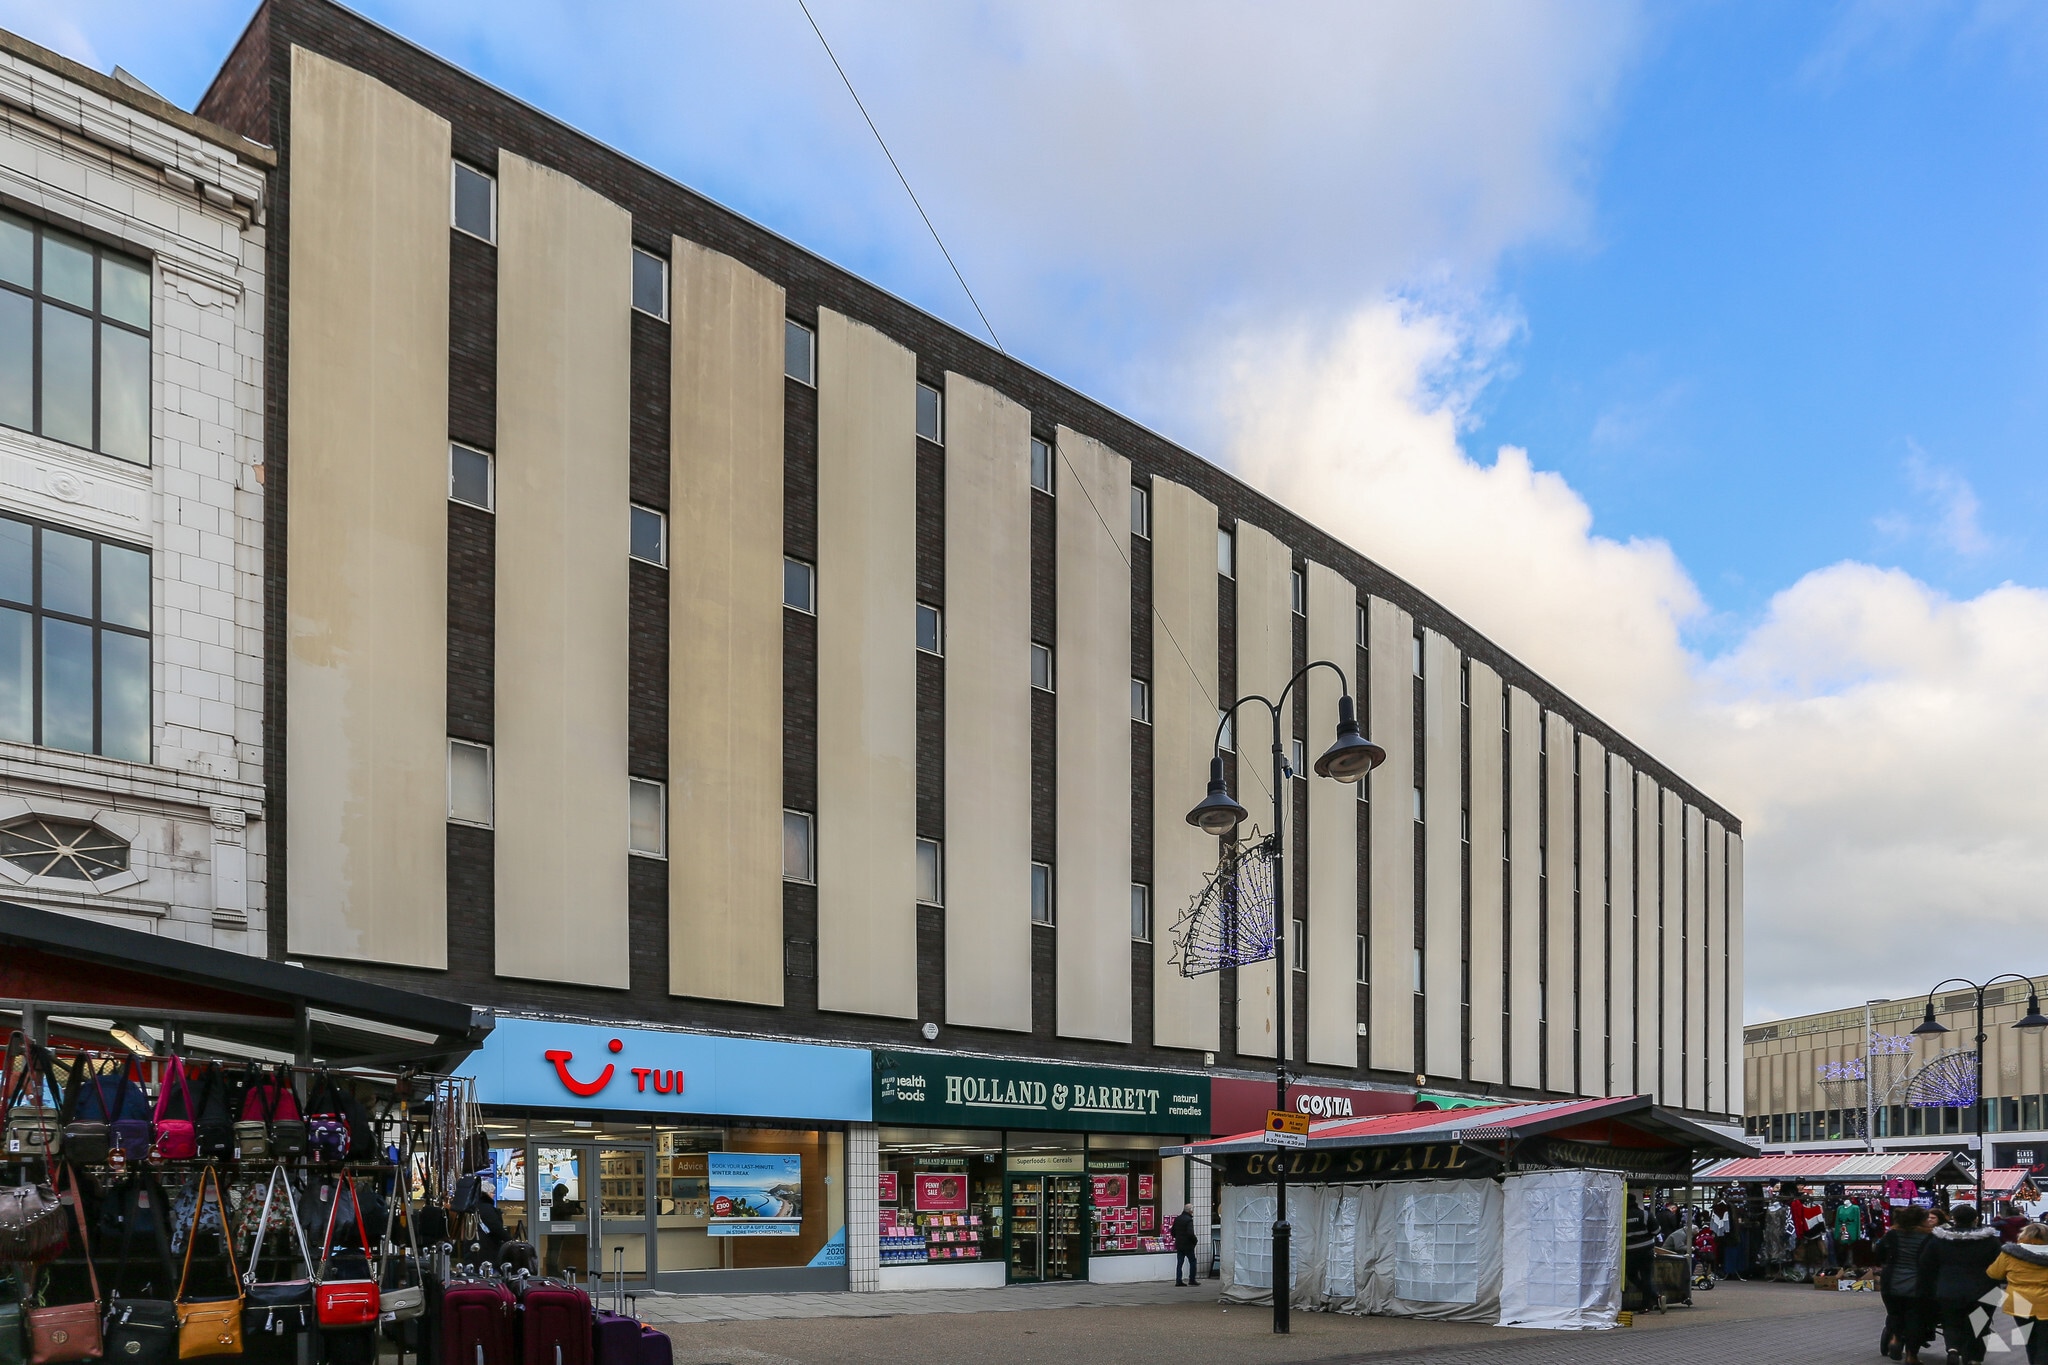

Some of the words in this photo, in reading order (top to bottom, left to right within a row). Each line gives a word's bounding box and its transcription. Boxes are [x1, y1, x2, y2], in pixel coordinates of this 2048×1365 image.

[631, 1067, 684, 1095] TUI
[896, 1088, 925, 1102] oods
[945, 1076, 1046, 1105] HOLLAND
[1052, 1083, 1068, 1110] &
[1074, 1084, 1160, 1114] BARRETT
[1173, 1094, 1198, 1104] natural
[1168, 1105, 1202, 1116] remedies
[1296, 1094, 1354, 1118] COSTA
[678, 1161, 704, 1170] Advice
[1346, 1145, 1467, 1172] STALL
